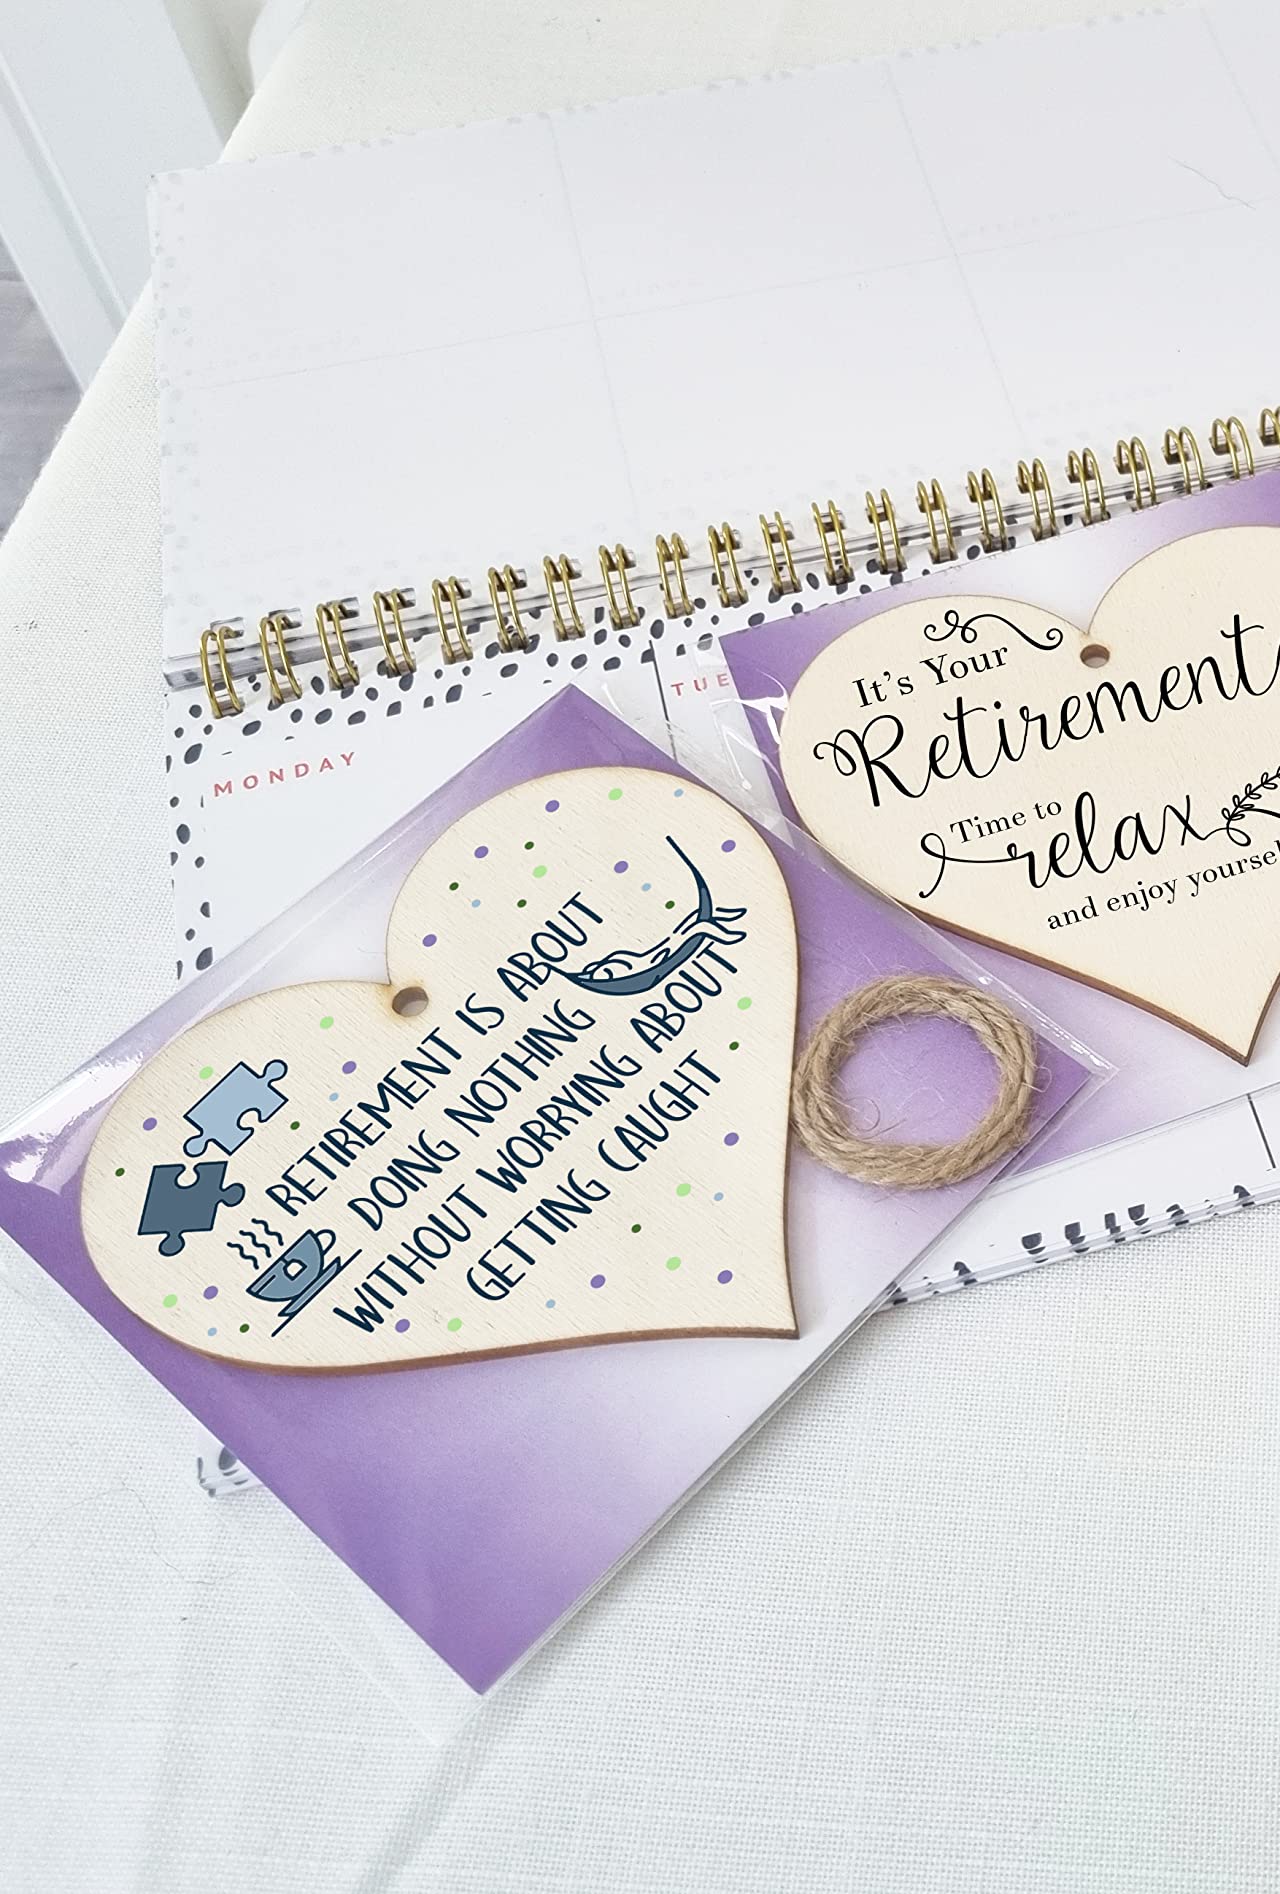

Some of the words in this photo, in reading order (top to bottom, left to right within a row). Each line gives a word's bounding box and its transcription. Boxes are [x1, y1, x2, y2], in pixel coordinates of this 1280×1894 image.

[853, 669, 914, 708] It's
[921, 644, 1009, 688] Your
[212, 750, 357, 798] MONDAY
[950, 808, 1027, 844] Time
[1032, 800, 1063, 823] to
[998, 791, 1250, 892] relax
[1046, 896, 1100, 931] and
[1106, 878, 1179, 912] enjoy
[265, 1026, 462, 1217] RETIREMENT
[457, 992, 504, 1034] IS
[496, 892, 604, 1002] ABOUT
[332, 1184, 488, 1332] WITHOUT
[476, 1044, 642, 1193] WORRYING
[629, 942, 738, 1053] ABOUT
[348, 1129, 460, 1231] DOING
[444, 998, 596, 1138] NOTHING
[466, 1168, 611, 1300] GETTING
[598, 1049, 721, 1172] CAUGHT
